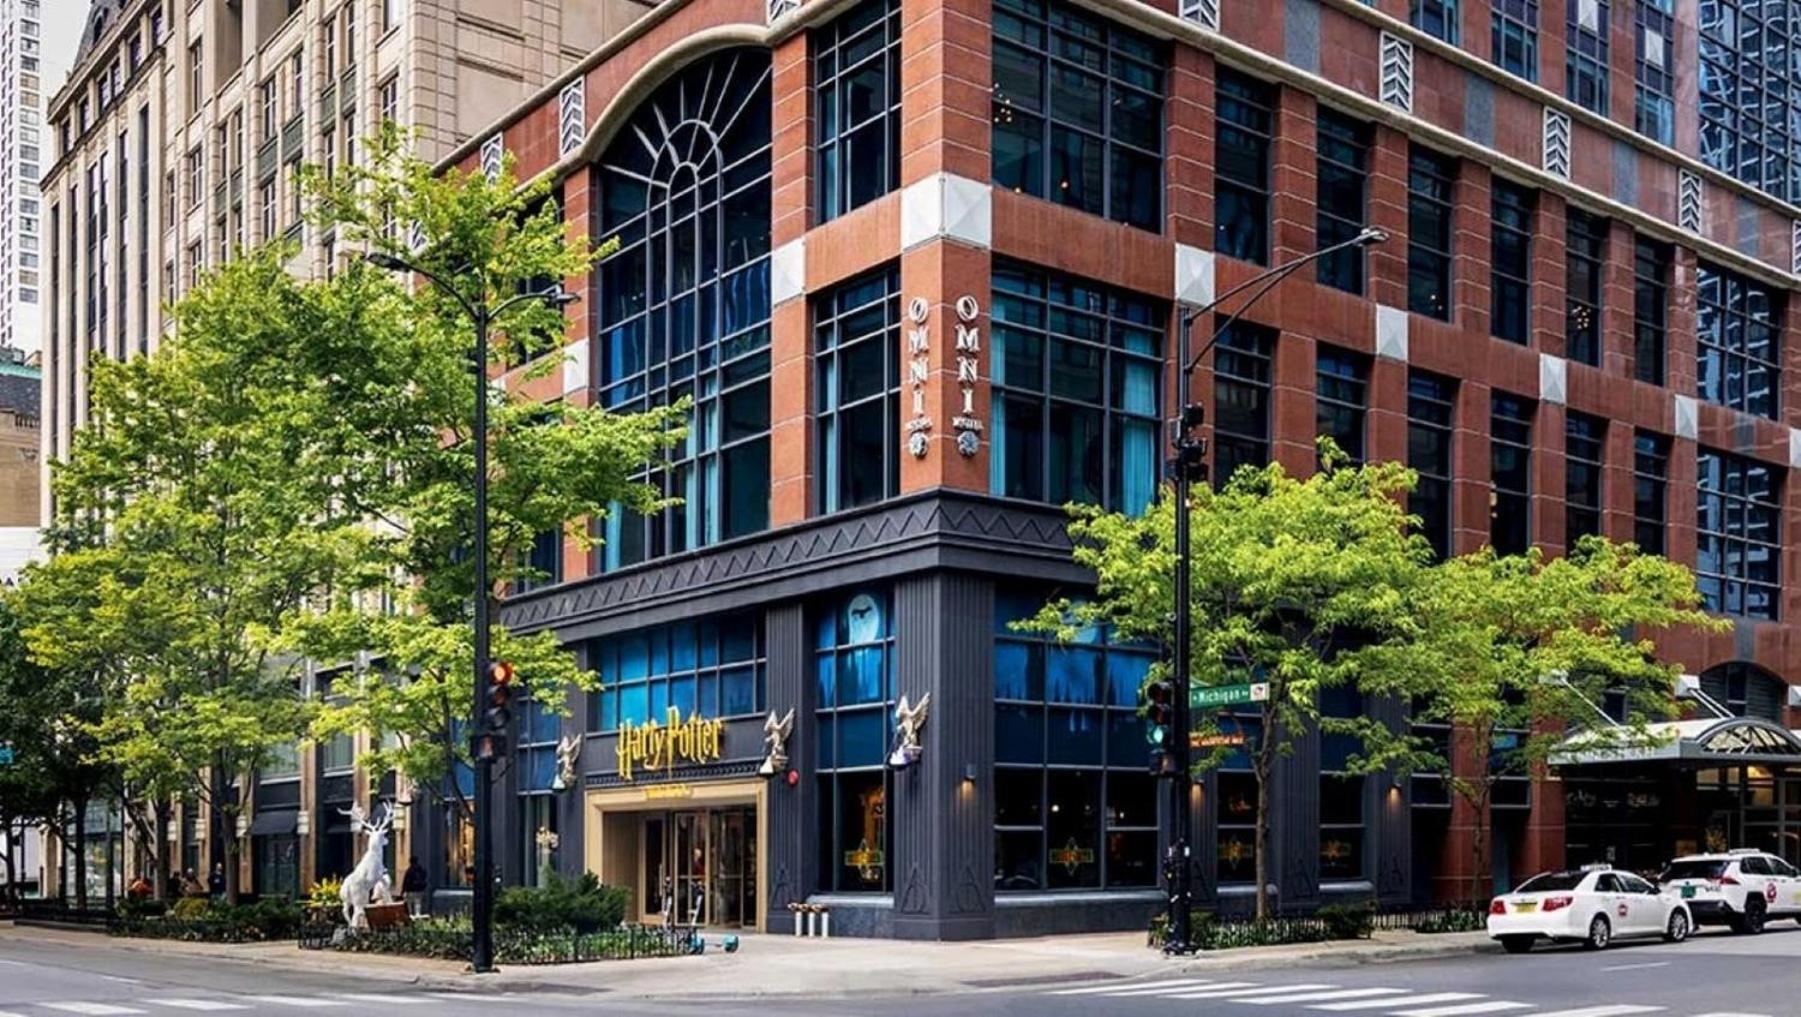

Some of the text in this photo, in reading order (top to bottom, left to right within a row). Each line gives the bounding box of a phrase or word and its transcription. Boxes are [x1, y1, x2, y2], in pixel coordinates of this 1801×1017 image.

[908, 296, 930, 414] OMNI
[955, 295, 981, 414] OMNI
[615, 705, 722, 780] Harry Potter
